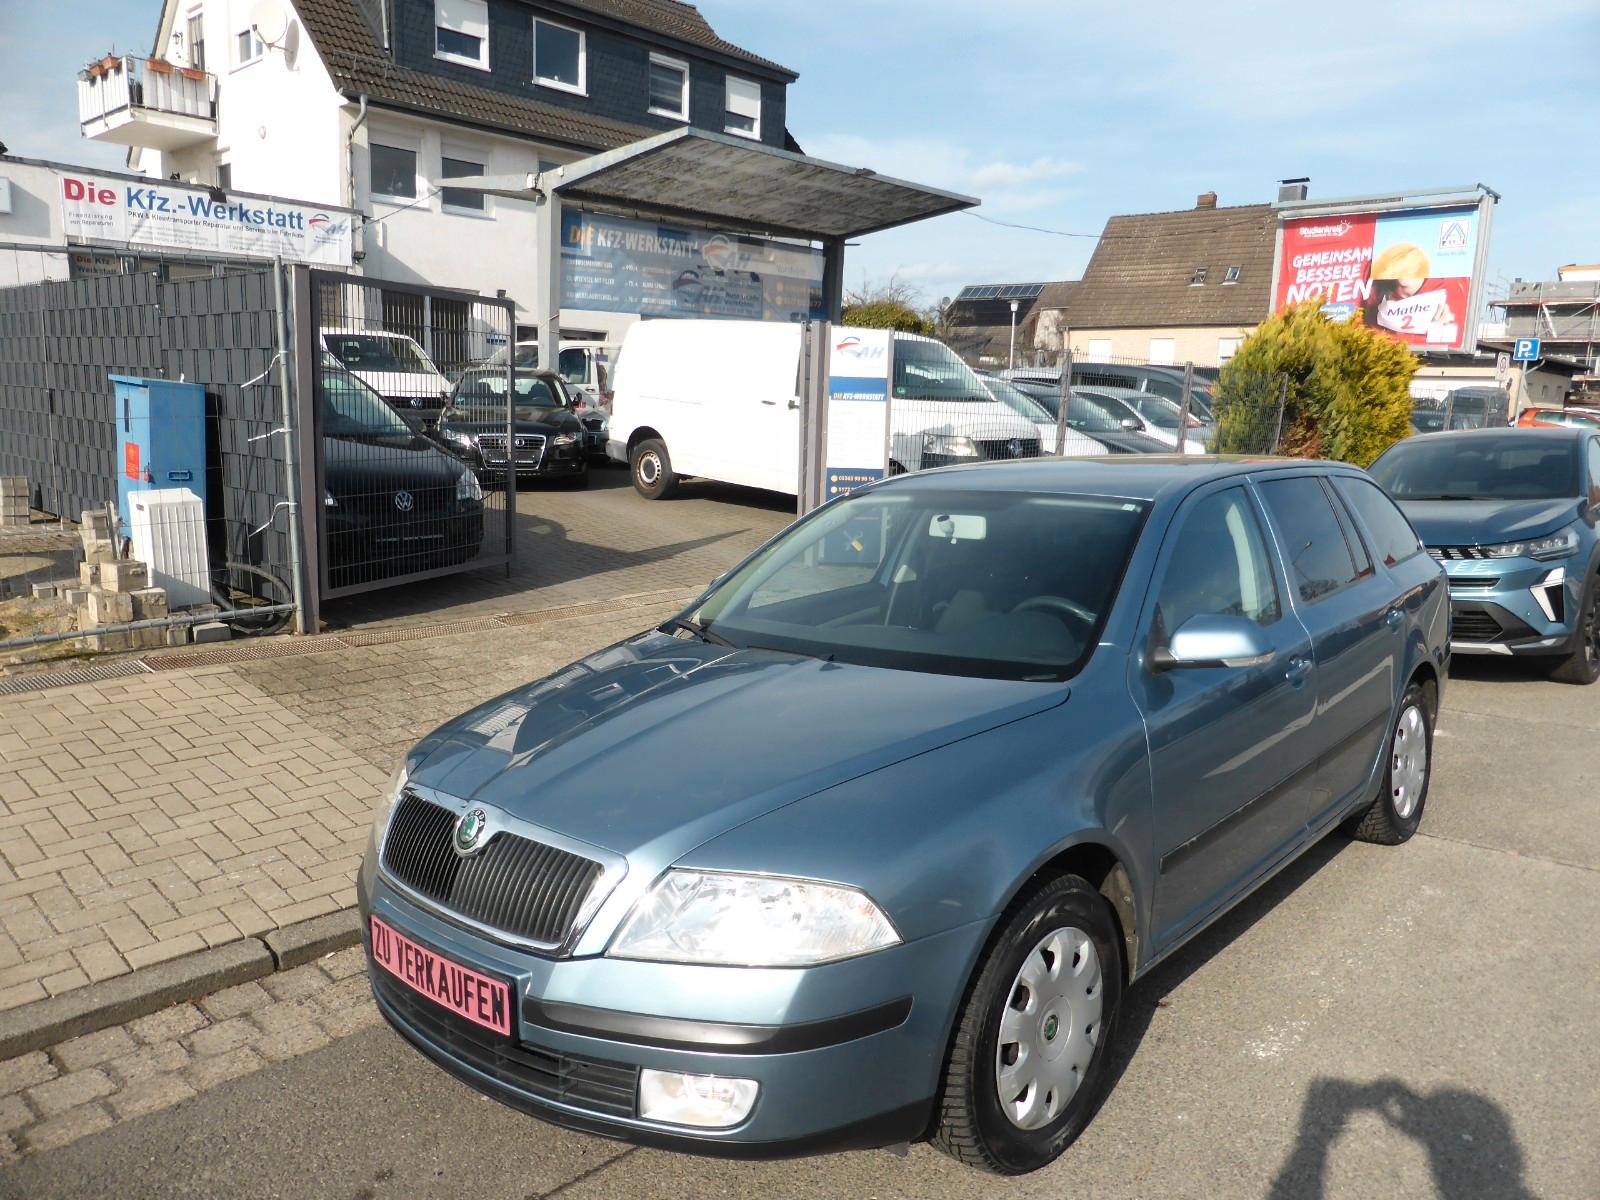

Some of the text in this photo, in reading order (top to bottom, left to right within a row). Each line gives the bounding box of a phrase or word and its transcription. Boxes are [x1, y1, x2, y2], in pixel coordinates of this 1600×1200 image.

[64, 178, 304, 231] Die Kfz.-Werkstatt
[128, 210, 144, 219] PKW
[151, 214, 201, 226] Kleintransporter
[202, 220, 231, 230] Reparatur
[597, 229, 693, 257] KFZ-WERKSTATT
[1293, 247, 1373, 268] GEMEINSAM
[1296, 264, 1361, 284] BESSERE
[1286, 279, 1374, 305] NOTEN
[1387, 303, 1431, 316] Mathe
[1401, 315, 1415, 330] 2
[1517, 341, 1532, 357] P
[843, 392, 885, 401] KFZ-WERKSTATT
[373, 921, 505, 1029] ZU VERKAUFEN
